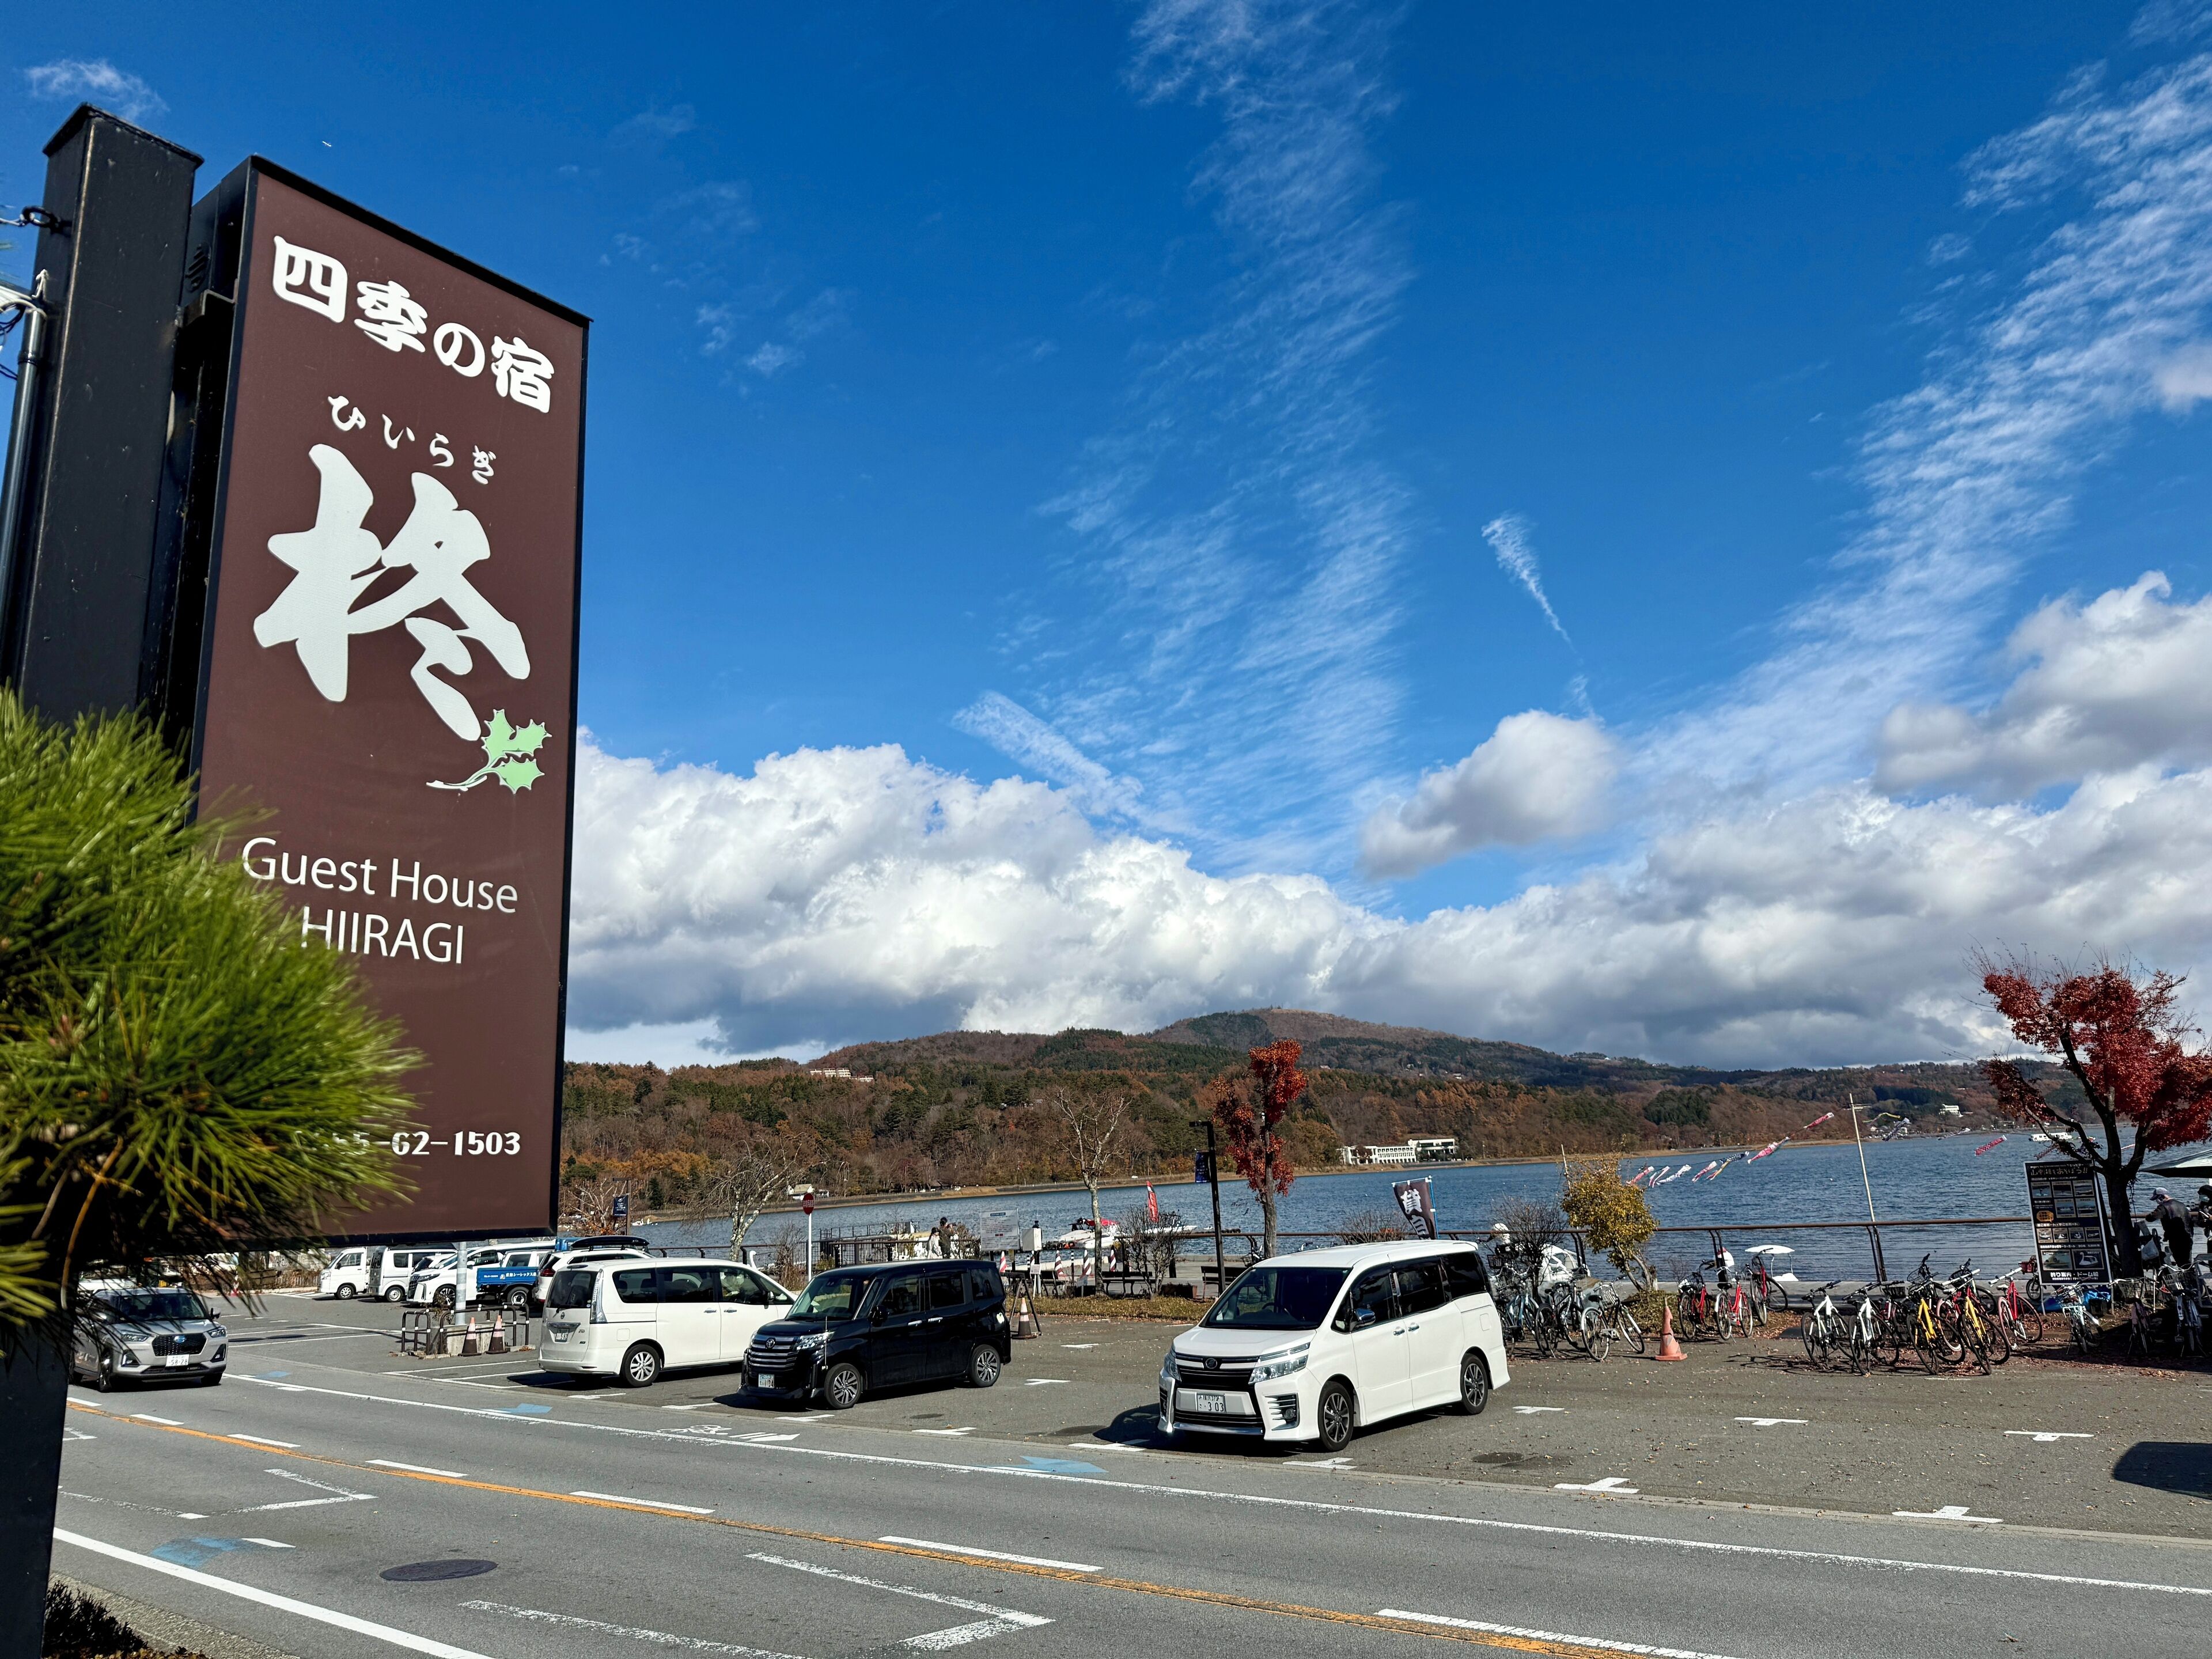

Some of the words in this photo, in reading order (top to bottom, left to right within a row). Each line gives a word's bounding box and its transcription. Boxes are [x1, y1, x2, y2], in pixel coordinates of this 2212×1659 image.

[272, 235, 555, 414] 四季の宿
[327, 395, 497, 485] ひいらぎ
[253, 443, 531, 741] 柊
[241, 837, 378, 896] Guest
[390, 858, 518, 914] House
[301, 906, 464, 964] HIIRAGI
